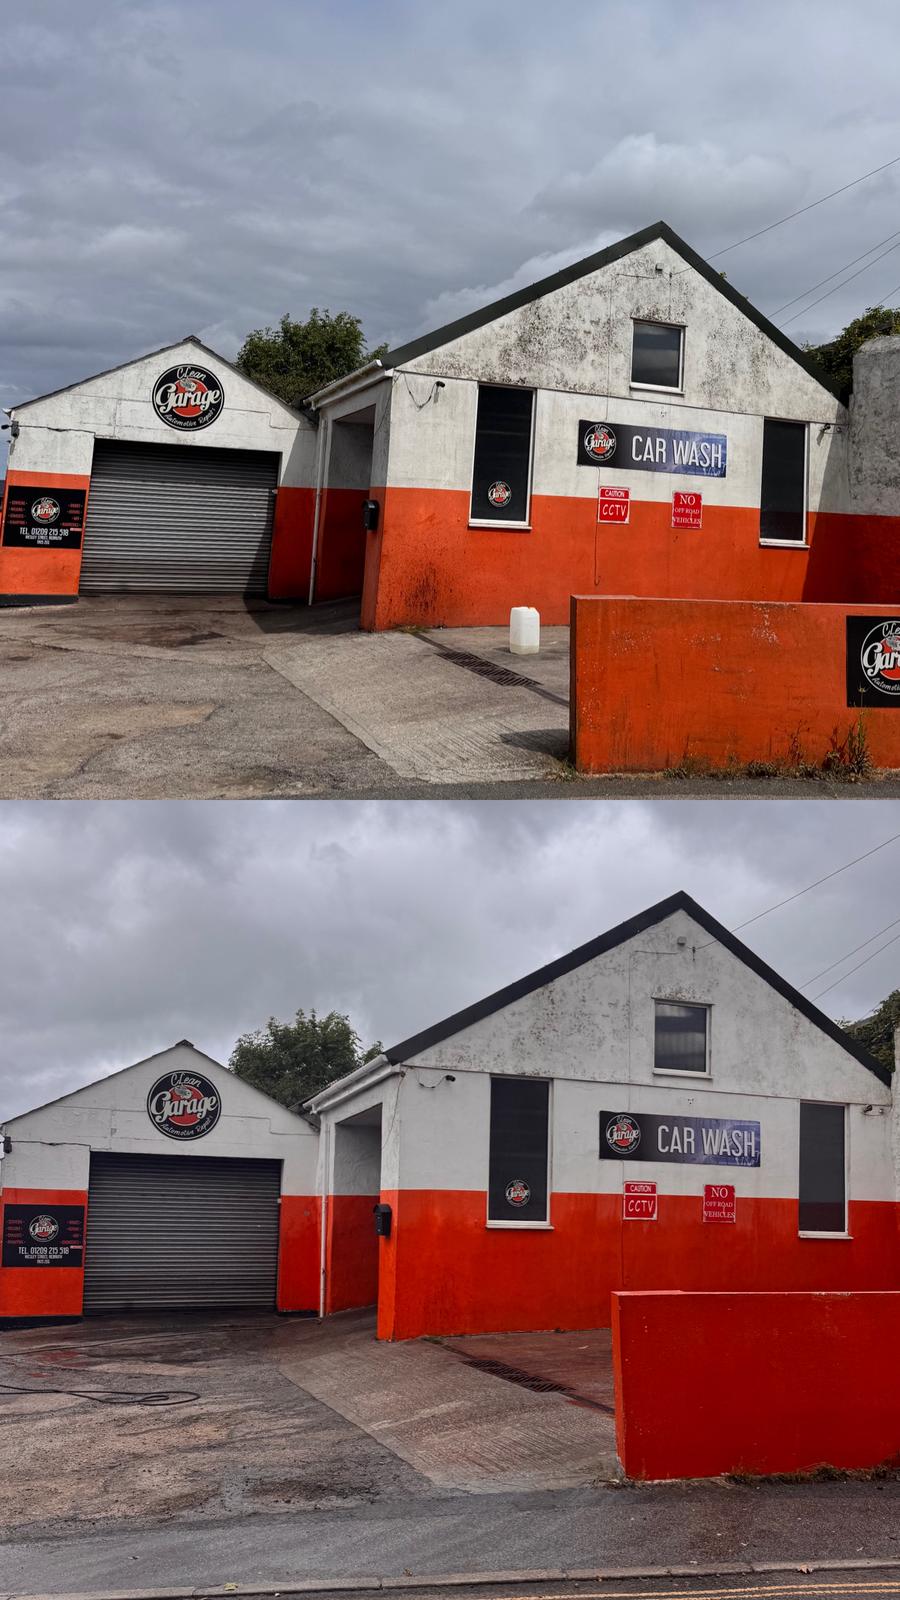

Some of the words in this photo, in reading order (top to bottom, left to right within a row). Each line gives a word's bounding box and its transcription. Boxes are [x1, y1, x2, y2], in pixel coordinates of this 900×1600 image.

[176, 367, 206, 381] Clean
[156, 383, 221, 413] Garage
[586, 434, 614, 450] Garage
[632, 436, 666, 463] CAR
[673, 440, 722, 468] WASH
[605, 490, 625, 498] CAUTION
[680, 494, 696, 505] NO
[602, 504, 626, 516] CCTV
[31, 528, 48, 536] 01209
[882, 622, 900, 638] Cle
[863, 642, 900, 676] Gar
[872, 678, 900, 691] Automoti
[171, 1073, 201, 1087] Clean
[150, 1091, 218, 1122] Garage
[608, 1126, 640, 1143] Garage
[658, 1126, 694, 1154] CAR
[702, 1128, 755, 1157] WASH
[630, 1184, 652, 1192] CAUTION
[711, 1187, 728, 1198] NO
[628, 1200, 653, 1212] CCTV
[30, 1246, 48, 1255] 01209
[48, 1247, 58, 1255] 215
[60, 1247, 70, 1255] 518
